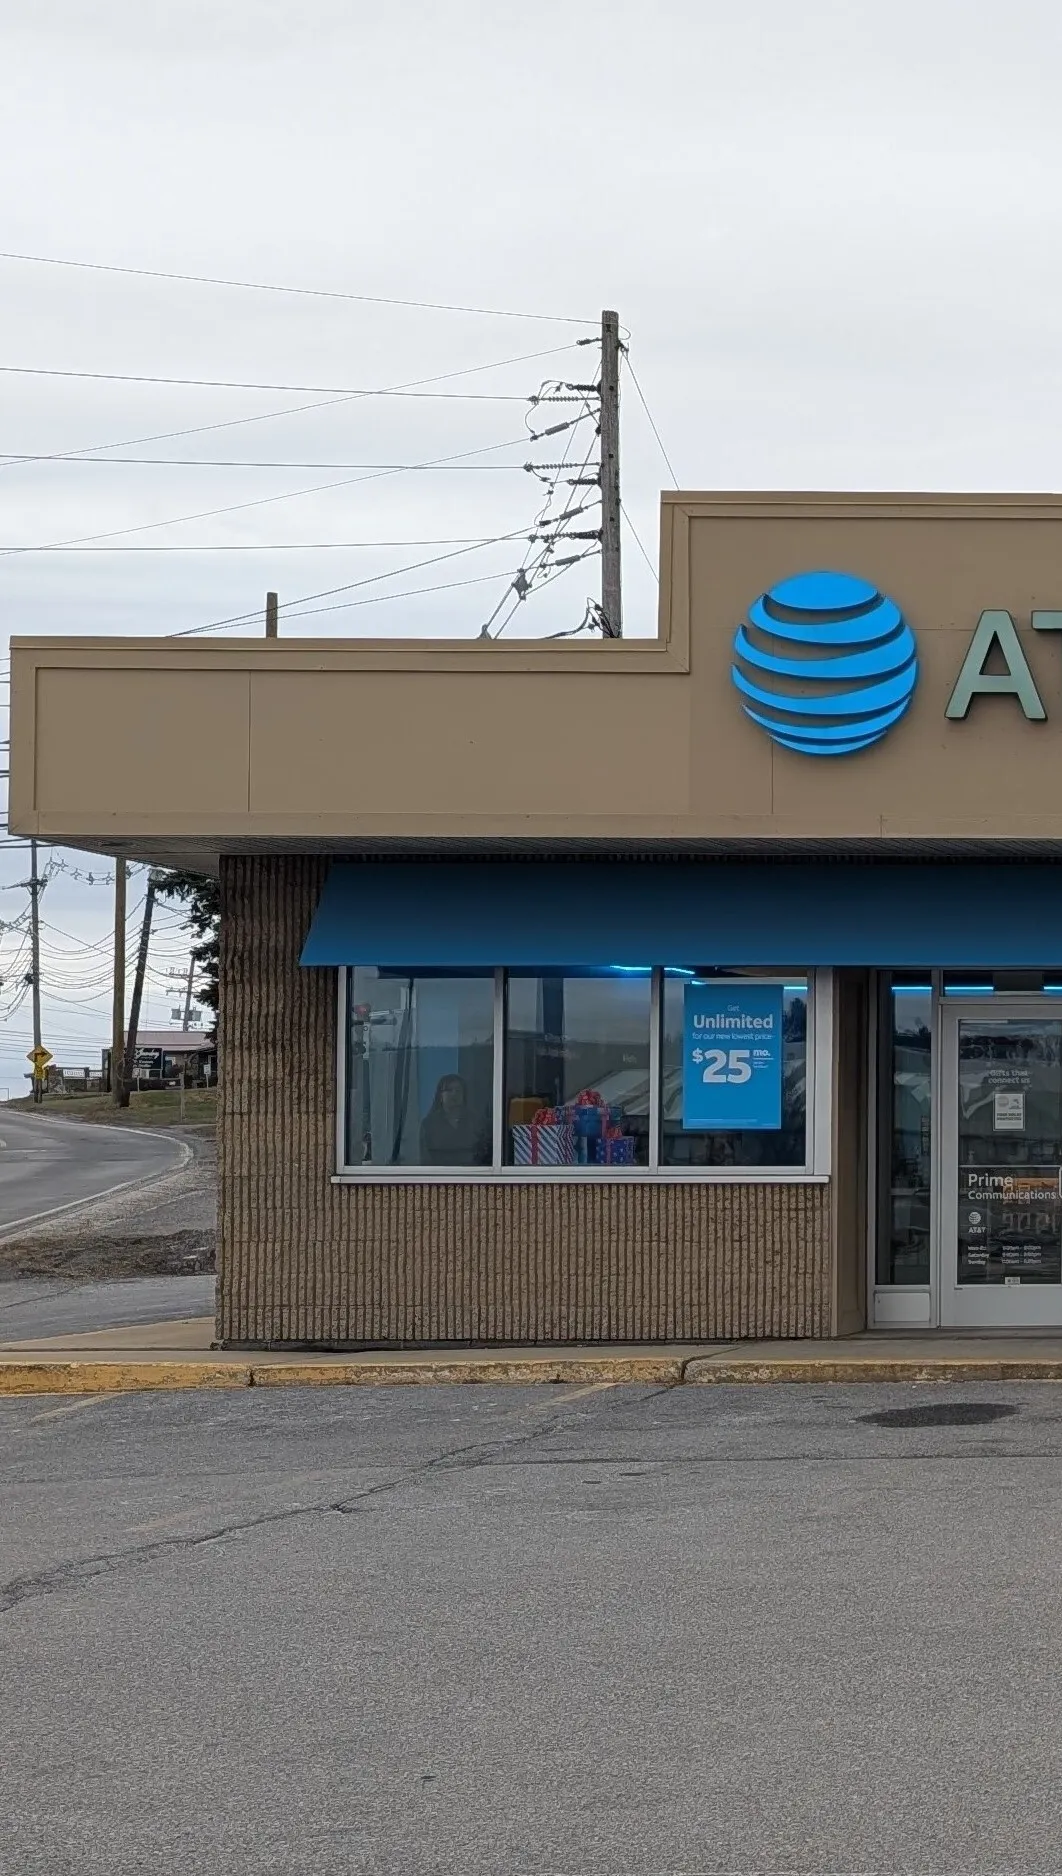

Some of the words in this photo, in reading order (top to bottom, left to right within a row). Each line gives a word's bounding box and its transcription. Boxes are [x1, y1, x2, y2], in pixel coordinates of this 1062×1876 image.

[694, 1014, 773, 1029] Unlimited
[692, 1032, 702, 1040] for
[968, 1172, 1014, 1187] Prime
[968, 1188, 1057, 1200] Communications
[968, 1226, 987, 1234] AT&T
